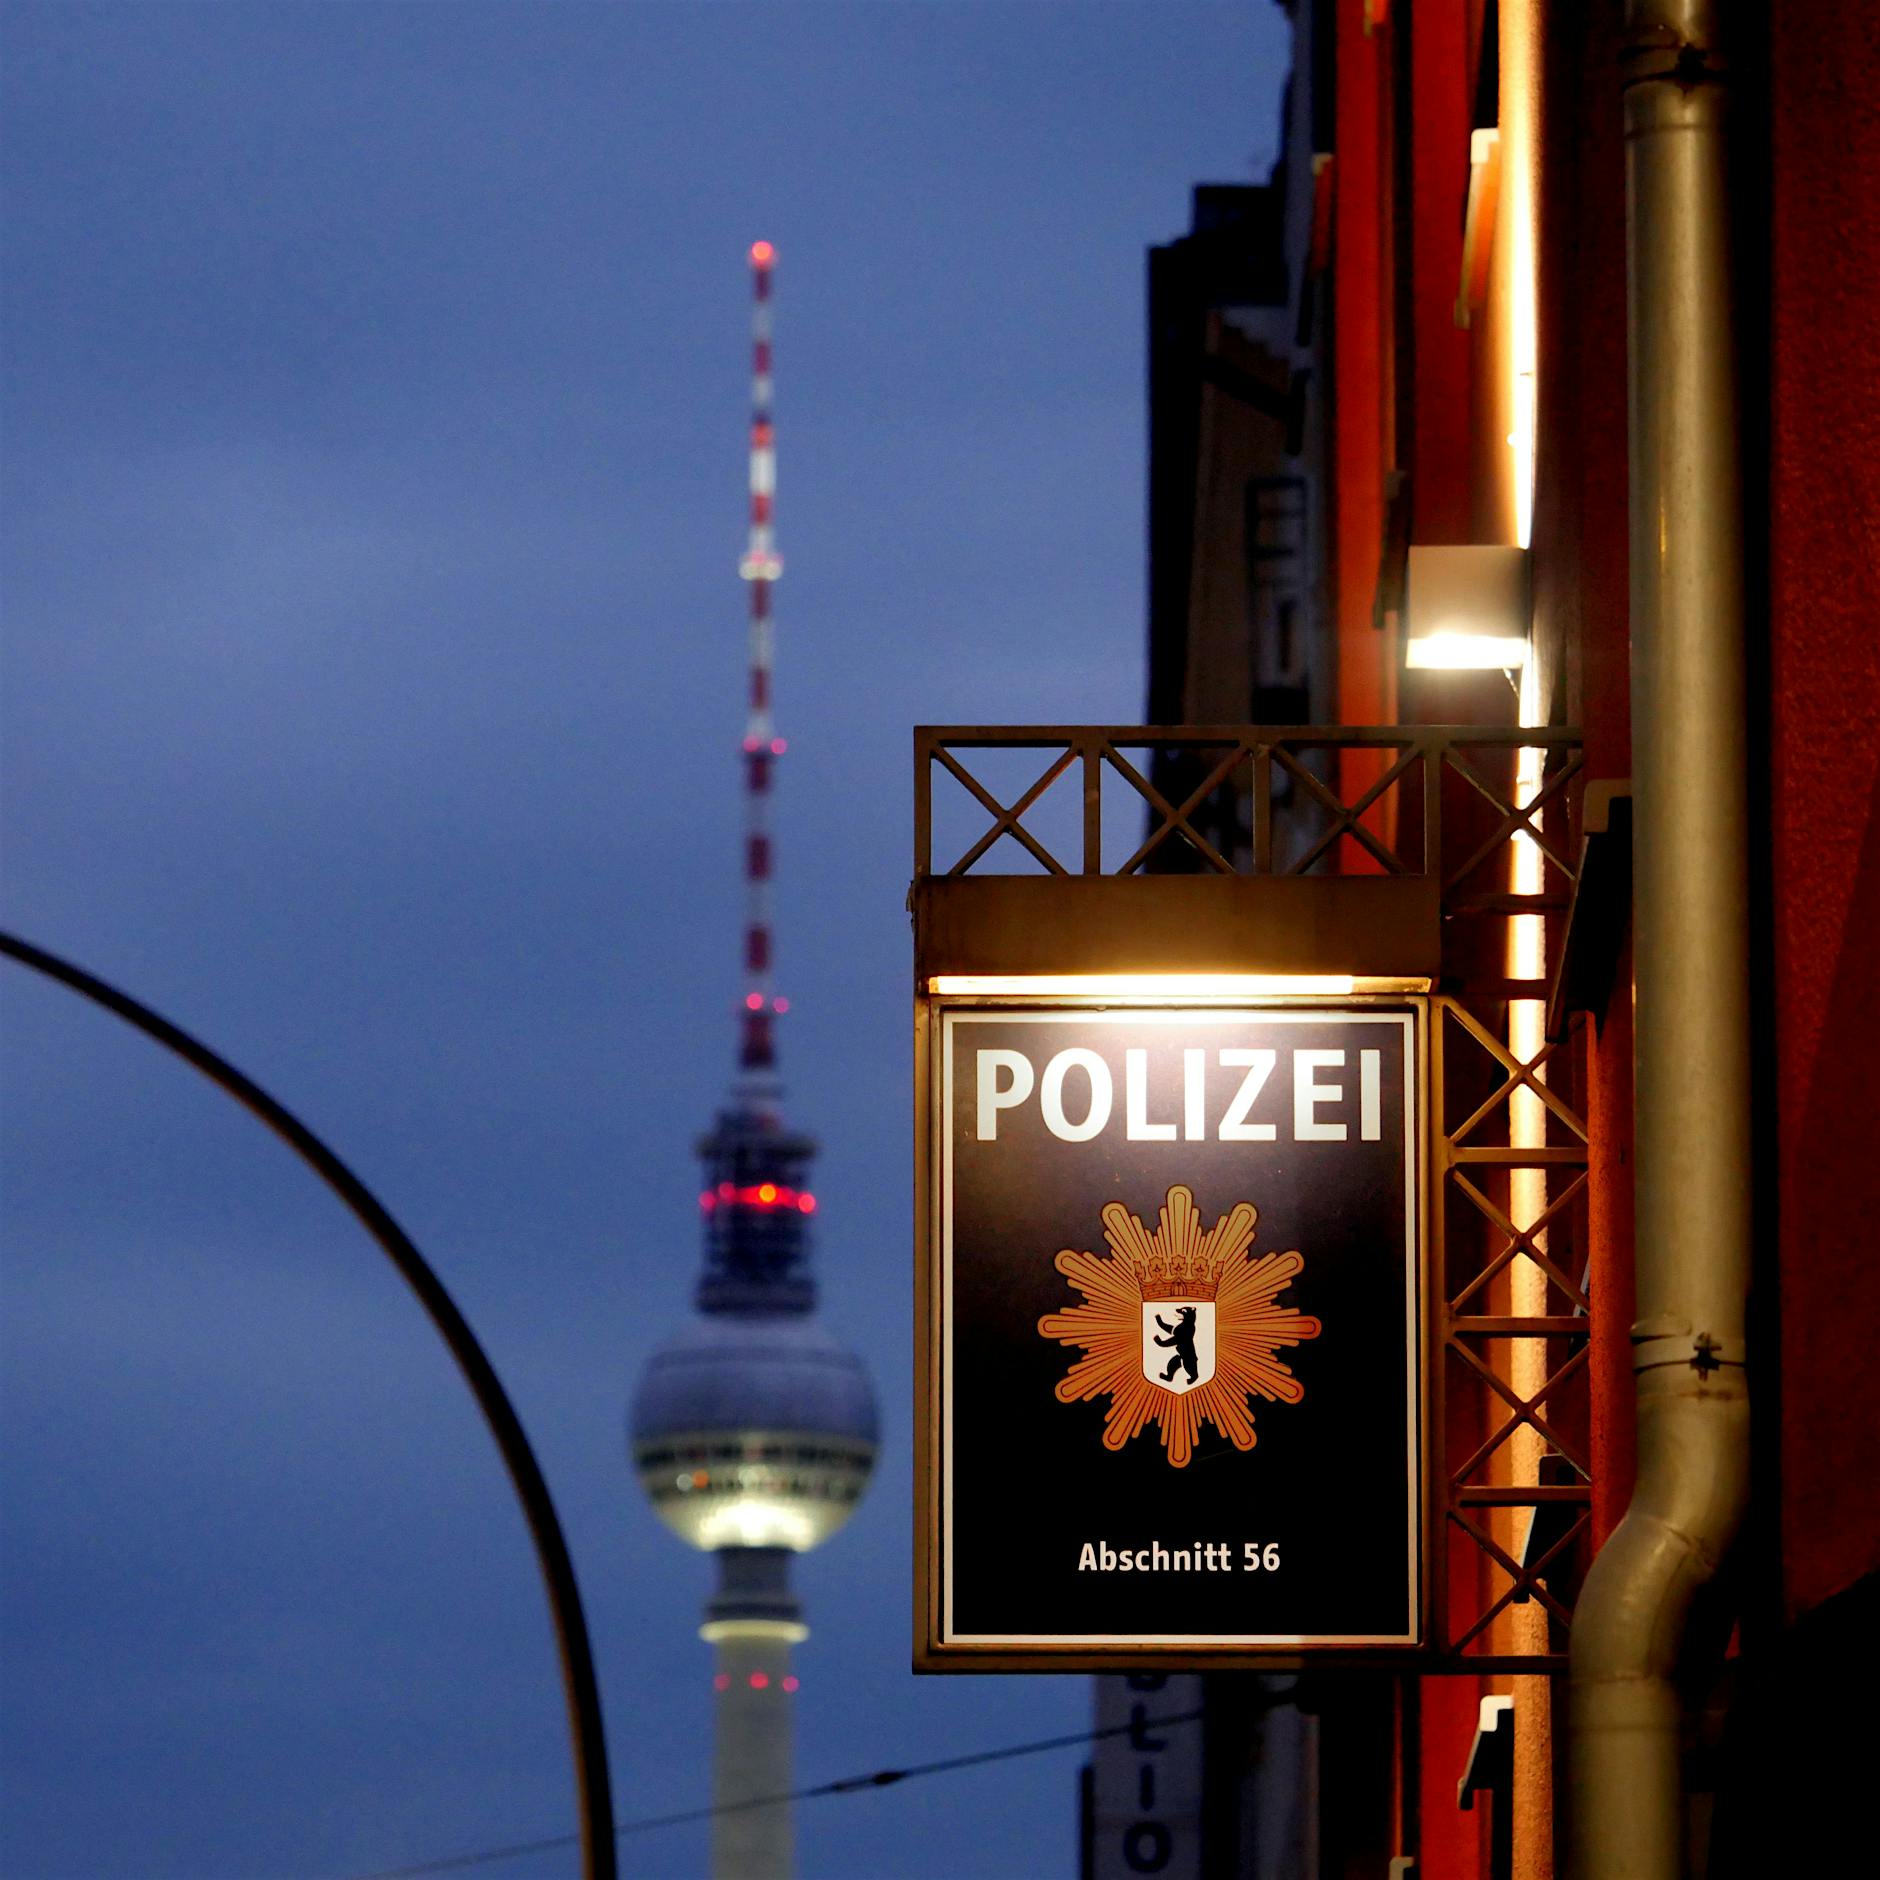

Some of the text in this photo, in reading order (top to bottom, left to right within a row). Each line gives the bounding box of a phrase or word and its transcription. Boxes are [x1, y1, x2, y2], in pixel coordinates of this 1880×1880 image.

[976, 1047, 1382, 1143] POLIZEI
[1078, 1540, 1281, 1573] Abschnitt 56
